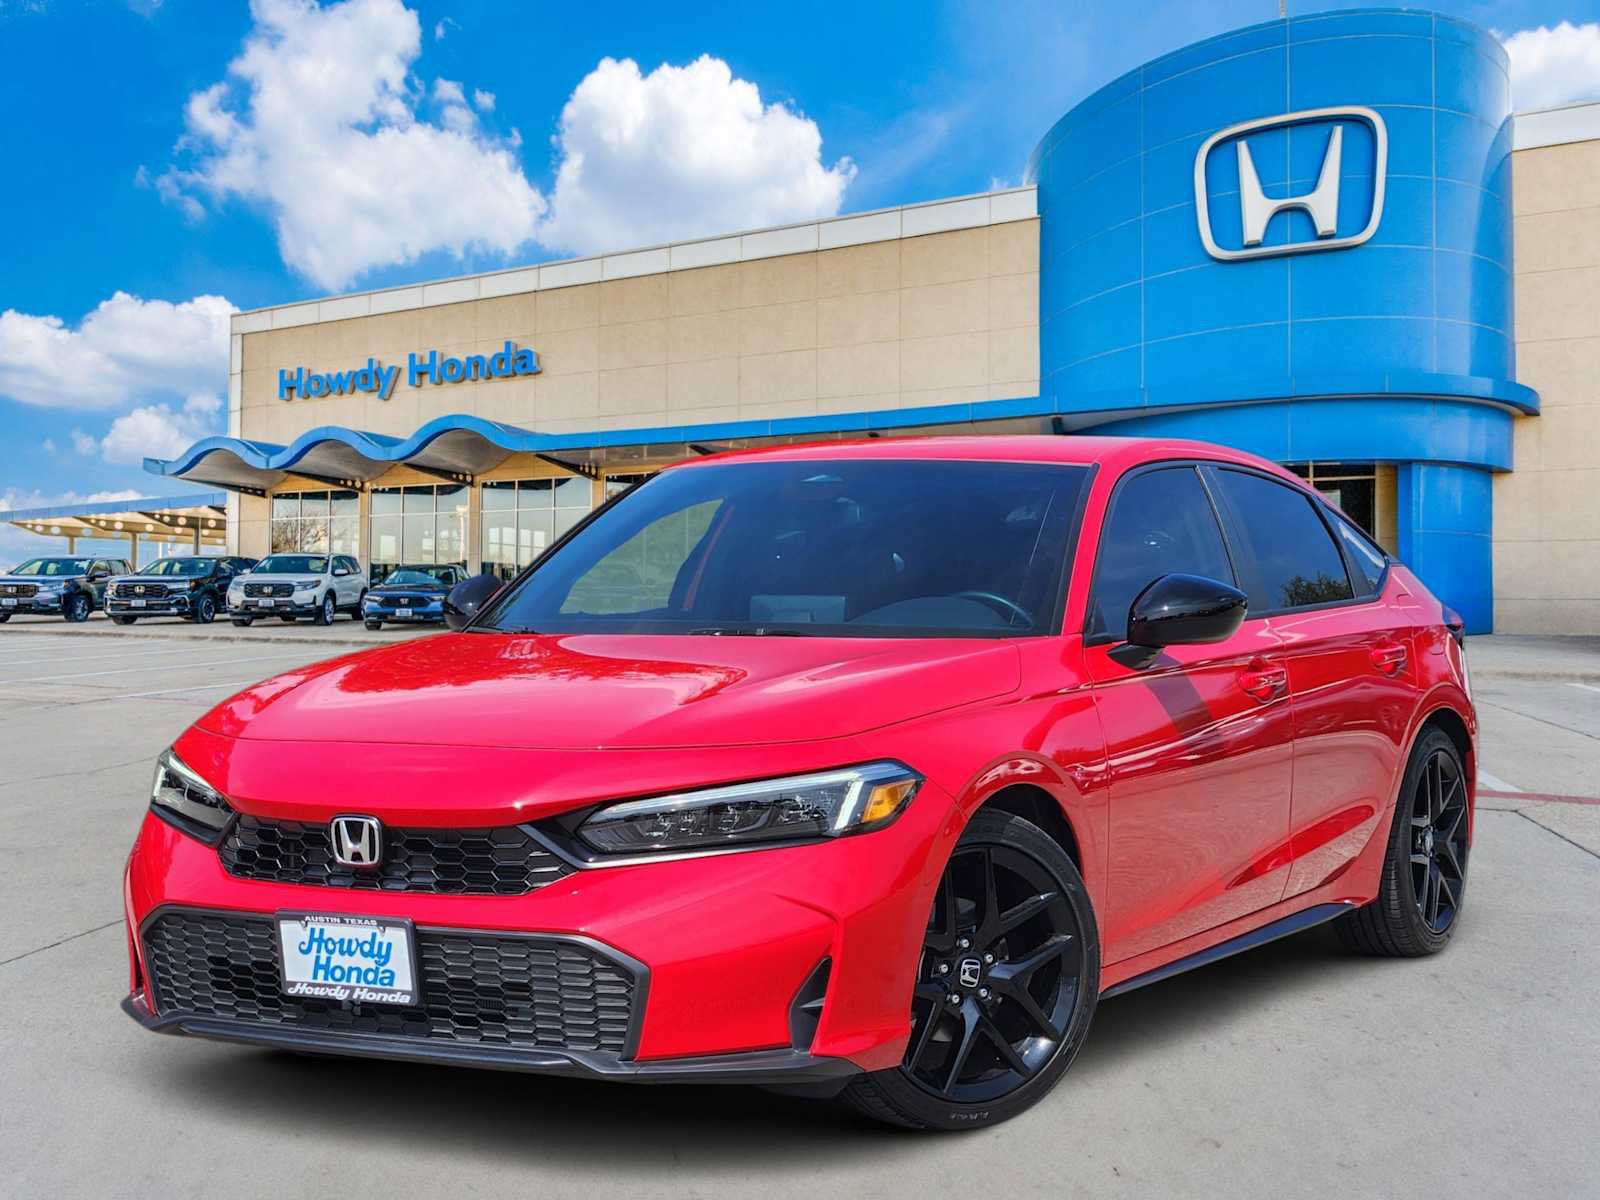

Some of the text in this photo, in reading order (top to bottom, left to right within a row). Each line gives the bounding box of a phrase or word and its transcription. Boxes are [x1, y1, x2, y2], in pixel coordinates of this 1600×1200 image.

[278, 340, 541, 401] Howdy Honda
[304, 915, 378, 926] AUSTIN TEXAS
[298, 927, 393, 967] Howdy
[312, 955, 396, 987] Honda
[287, 982, 411, 1004] Howdy Honda
